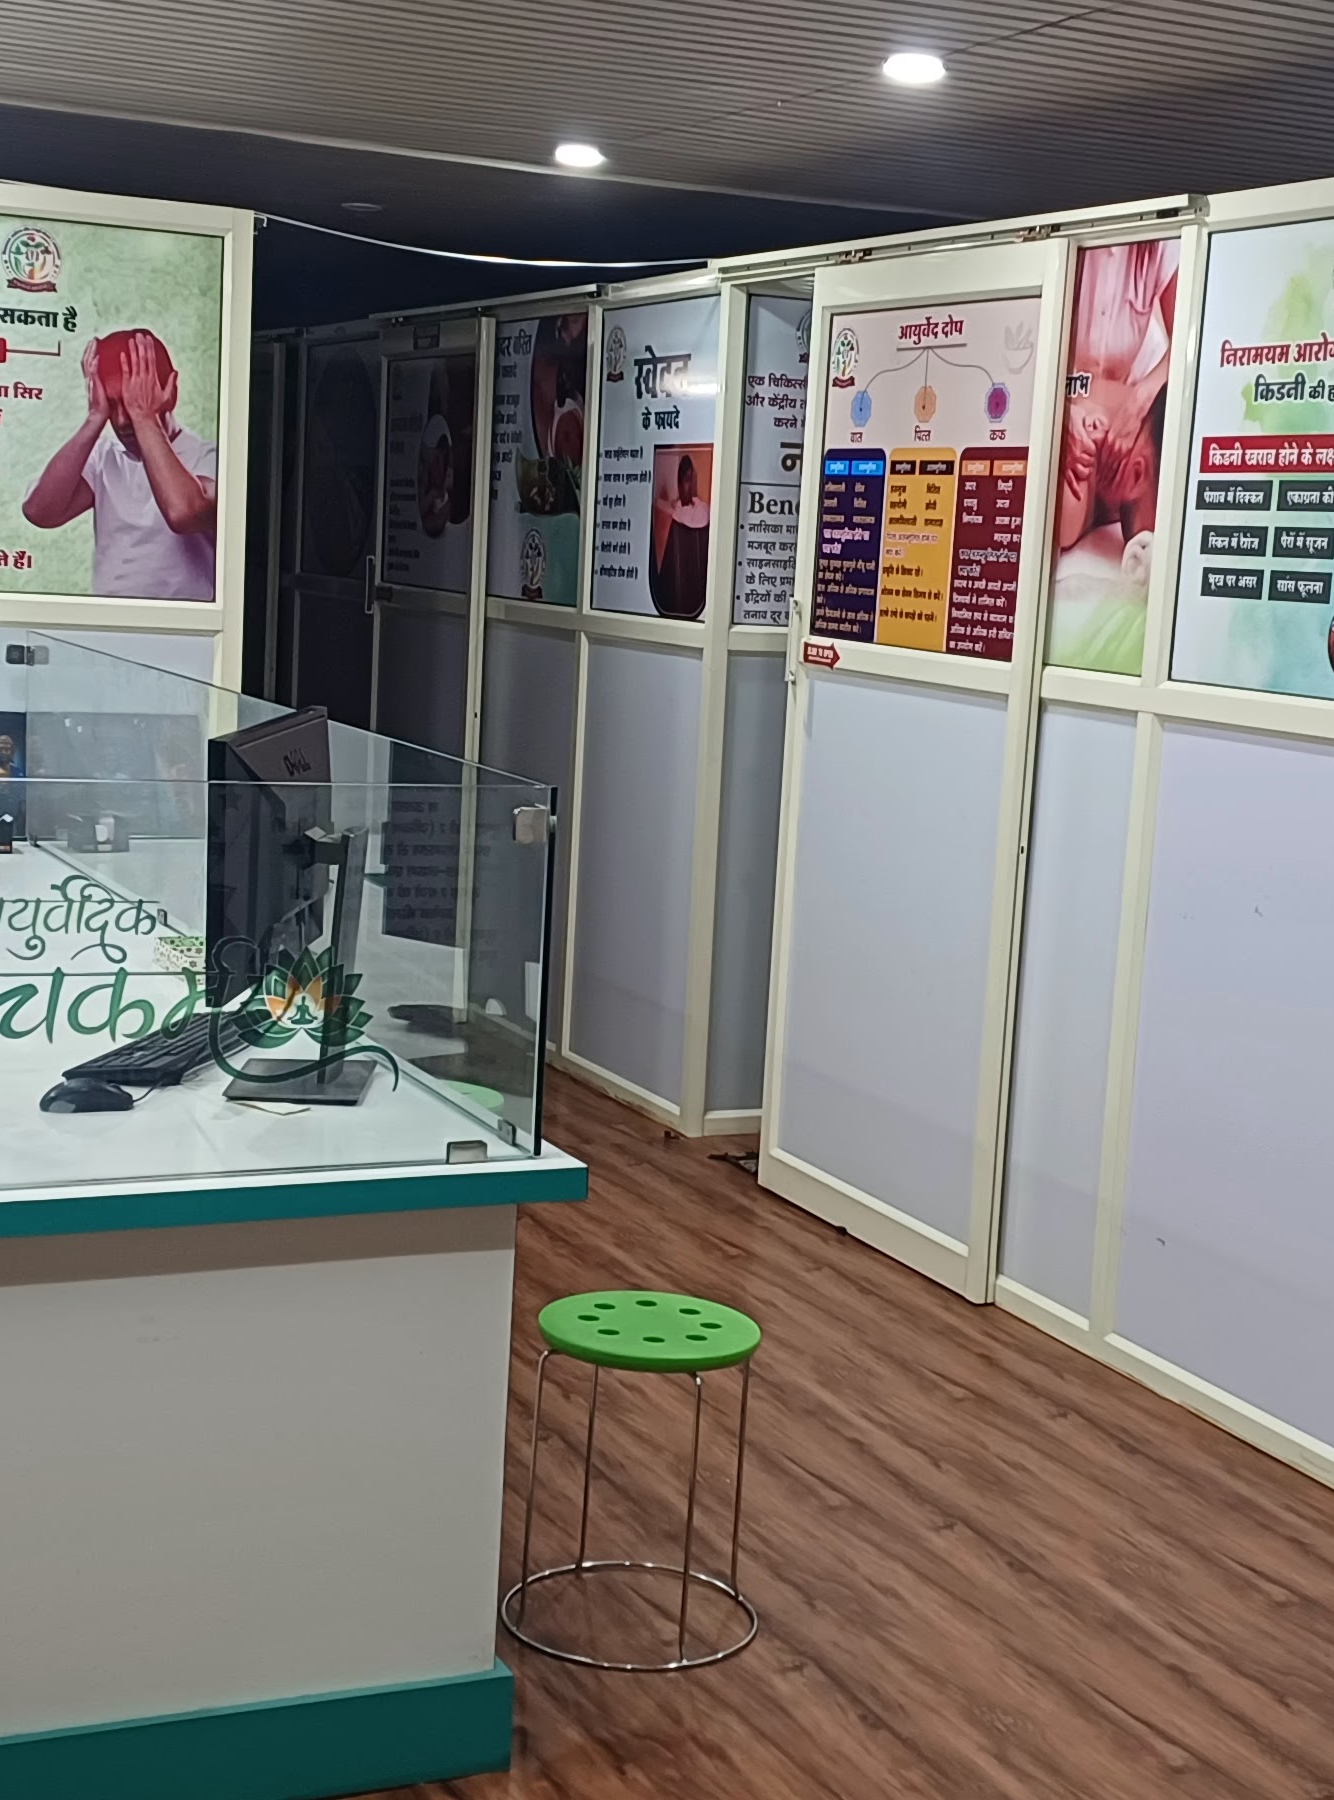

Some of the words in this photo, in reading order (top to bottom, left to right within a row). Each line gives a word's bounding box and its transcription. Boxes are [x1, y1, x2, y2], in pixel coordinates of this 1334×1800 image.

[62, 306, 77, 332] है
[898, 316, 939, 344] आयुर्वेद
[1220, 338, 1291, 368] निरामयम
[748, 376, 765, 388] एक
[1254, 373, 1306, 402] किडनी
[1308, 382, 1324, 399] की
[13, 382, 43, 400] सिर
[746, 392, 765, 407] और
[641, 411, 652, 431] के
[655, 405, 680, 429] फायदे
[1208, 442, 1241, 466] किडनी
[1245, 449, 1276, 466] खराब
[1279, 442, 1297, 466] होने
[1301, 442, 1312, 464] के
[1322, 488, 1333, 503] की
[748, 520, 783, 534] नासिका
[747, 541, 776, 555] मजबूत
[1225, 575, 1236, 587] पर
[1238, 576, 1257, 589] असर
[774, 590, 786, 603] की
[743, 610, 767, 620] तनाव
[770, 610, 782, 624] दूर
